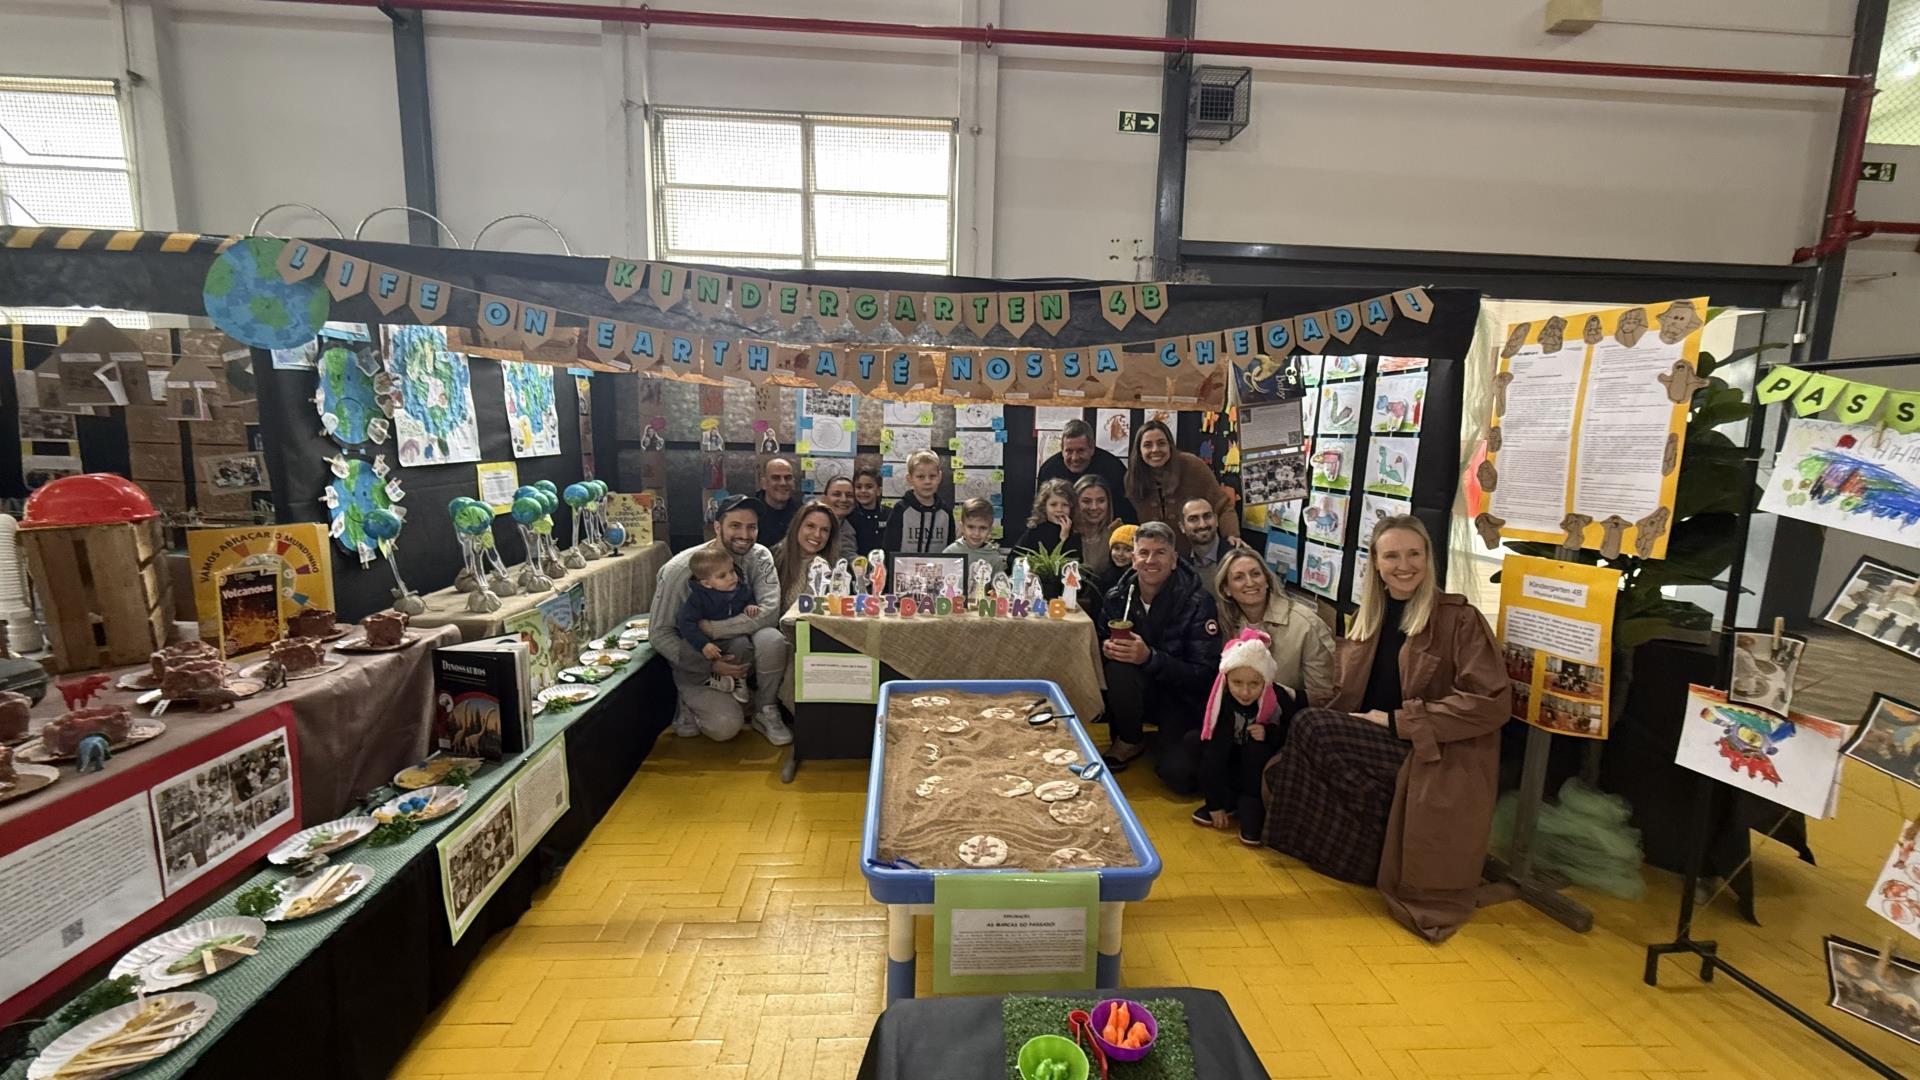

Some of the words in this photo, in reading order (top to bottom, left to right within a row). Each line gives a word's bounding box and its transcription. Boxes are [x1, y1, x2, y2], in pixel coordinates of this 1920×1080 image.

[290, 243, 440, 310] LIFE
[484, 301, 555, 337] ON
[596, 320, 769, 370] EARTH
[815, 350, 910, 385] ATÉ
[951, 347, 1119, 381] NOSSA
[613, 261, 1063, 323] KINDERGARTEN
[1109, 284, 1161, 316] 4B
[201, 551, 220, 583] VAMOS
[220, 531, 271, 552] ABRAÇAR
[284, 535, 319, 573] MUNDINHO
[222, 585, 273, 599] Volcanoes
